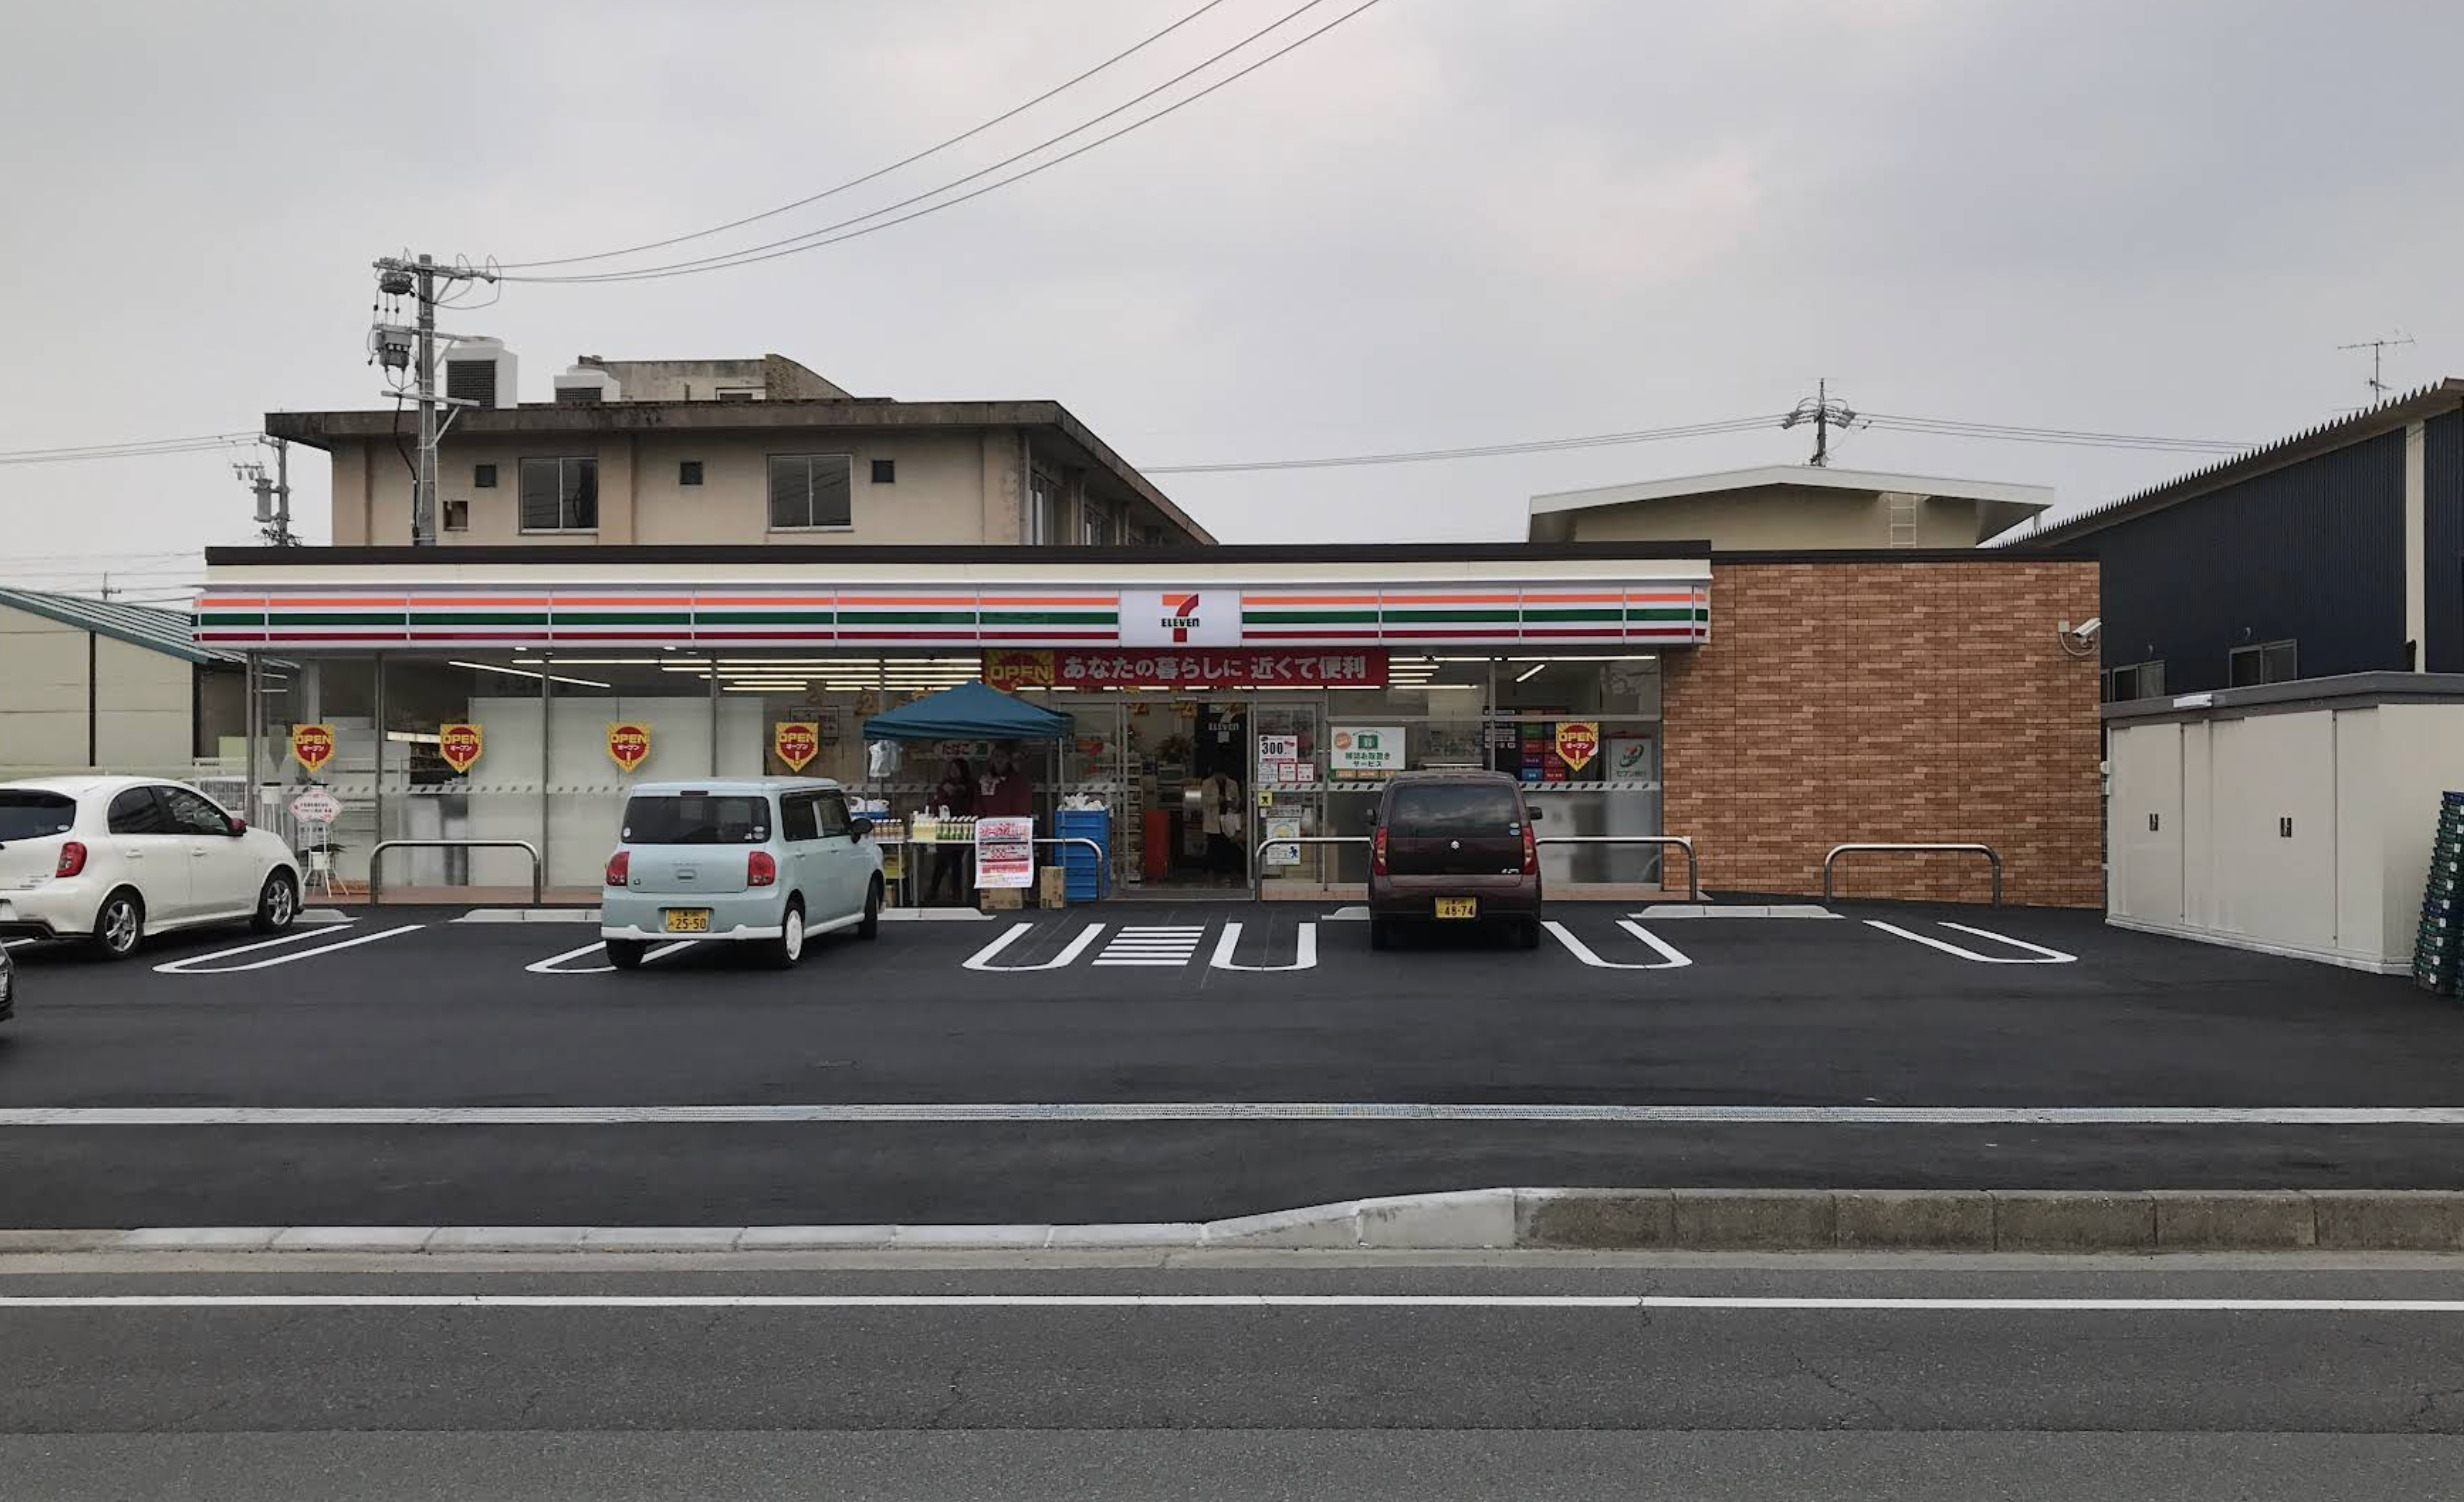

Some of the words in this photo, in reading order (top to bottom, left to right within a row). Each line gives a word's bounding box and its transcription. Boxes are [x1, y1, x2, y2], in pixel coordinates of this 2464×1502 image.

[1063, 656, 1243, 680] あなたの暮らしに
[1250, 655, 1366, 680] 近くて便利
[295, 735, 332, 745] OPEN
[442, 735, 479, 745] OPEN
[610, 733, 647, 743] OPEN
[778, 733, 816, 743] OPEN
[1558, 732, 1596, 742] OPEN
[1261, 742, 1283, 755] 300
[1444, 905, 1473, 916] 48-74
[675, 918, 706, 929] 25-50
